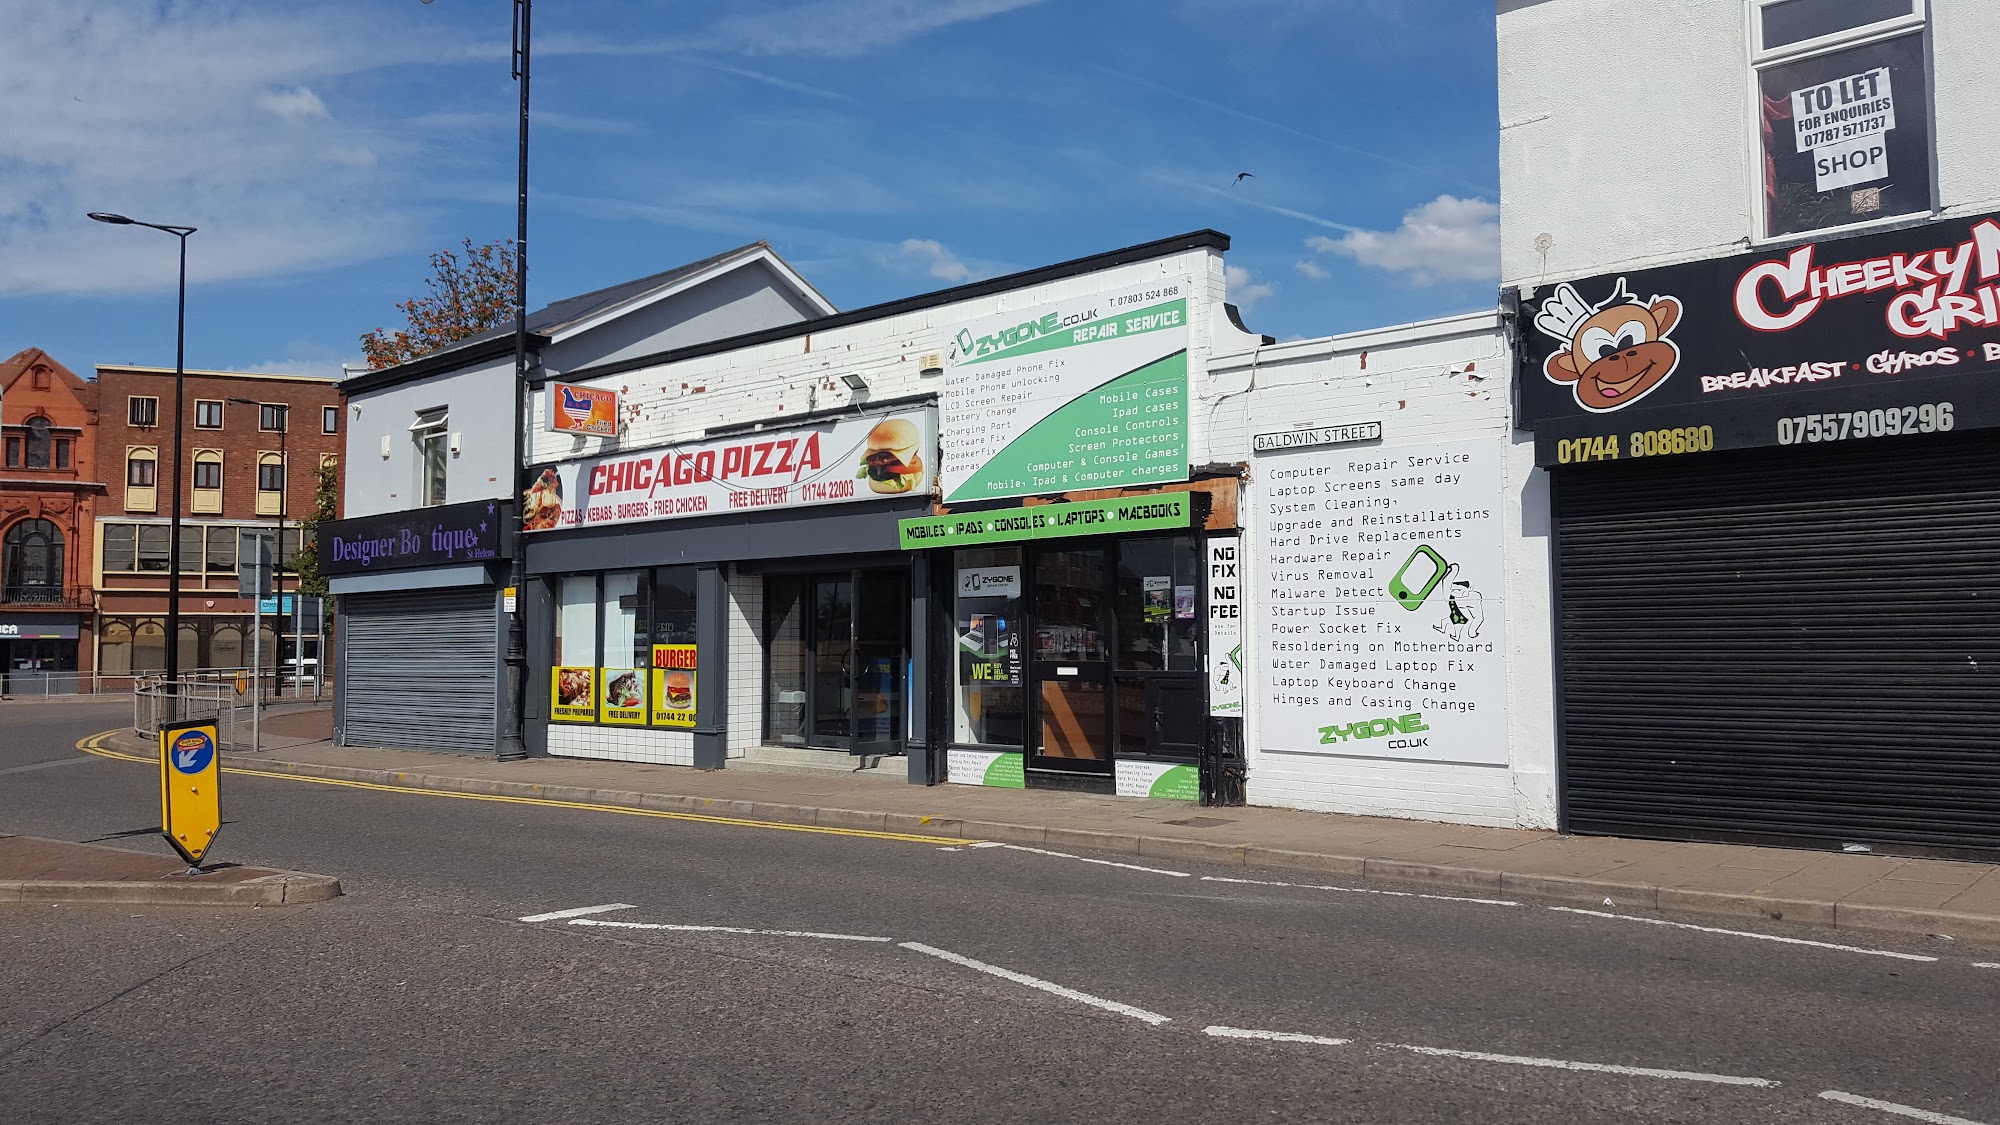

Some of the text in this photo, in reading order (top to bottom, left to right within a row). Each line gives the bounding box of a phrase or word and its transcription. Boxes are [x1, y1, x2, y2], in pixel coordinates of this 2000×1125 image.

[1800, 72, 1879, 115] TO LET
[1798, 97, 1890, 132] FOR ENQUIRIES
[1805, 115, 1886, 147] 07787 571737
[1818, 146, 1883, 176] SHOP
[1118, 293, 1142, 306] 07803
[1145, 290, 1160, 301] 524
[1162, 286, 1178, 297] 868
[1886, 283, 2000, 340] GRI
[1073, 310, 1180, 343] REPAIR SERVICE
[946, 359, 1065, 386] Water Damaged Phone Fix
[1701, 360, 1847, 394] BREAKFAST
[1866, 346, 1960, 375] GYROS
[946, 373, 1059, 398] Mobile Phone unlocking
[1100, 386, 1178, 404] Mobile Cases
[574, 391, 612, 402] CHICAGO
[946, 391, 1032, 411] LCD Screen Repair
[946, 406, 1016, 423] Battery Change
[1113, 402, 1178, 418] Ipad cases
[946, 421, 1011, 437] Charging Port
[1075, 416, 1178, 437] Console Controls
[1777, 402, 1954, 445] 07557909296
[946, 434, 1006, 448] Software Fix
[1069, 432, 1178, 453] Screen Protectors
[1258, 424, 1376, 449] BALDWIN STREET
[1557, 425, 1714, 464] 01744 808680
[588, 432, 821, 498] CHICAGO PIZZA
[946, 462, 980, 473] Cameras
[1027, 459, 1074, 472] Computer
[1081, 457, 1086, 466] &
[1094, 452, 1138, 465] Console
[1269, 453, 1470, 480] Computer Repair Service
[1033, 476, 1056, 487] Ipad
[1063, 474, 1068, 483] &
[1075, 469, 1124, 482] Computer
[1132, 463, 1178, 476] charges
[1270, 471, 1461, 498] Laptop Screens same day
[729, 479, 854, 508] FREE DELIVERY 01744 22003
[561, 496, 708, 525] PIZZAS KEBABS BURGERS FRIED CHICKEN
[1270, 502, 1315, 515] System
[907, 502, 1181, 540] MOBILES IPADS CONSOLES LAPTOPS MACBOOKS
[1270, 508, 1490, 533] Upgrade and Reinstallations
[1270, 528, 1462, 547] Hard Drive Replacements
[333, 534, 395, 566] Designer
[467, 549, 495, 559] St Helens
[1214, 547, 1234, 561] NO
[1270, 550, 1391, 564] Hardware Repair
[982, 576, 1013, 584] ZYGONE
[1212, 564, 1236, 578] FIX
[1271, 569, 1373, 582] Virus Removal
[1215, 586, 1235, 599] NO
[1272, 586, 1384, 599] Malware Detect
[1210, 605, 1238, 618] FEE
[1272, 605, 1376, 617] Startup Issue
[1272, 622, 1401, 634] Power Socket Fix
[1273, 641, 1493, 654] Resoldering on Motherboard
[972, 663, 991, 680] WE
[1272, 659, 1475, 673] Water Damaged Laptop Fix
[1273, 676, 1456, 692] Laptop Keyboard Change
[554, 707, 594, 717] FRESHLY PREPARED
[1273, 693, 1475, 713] Hinges and Casing Change
[608, 710, 640, 720] FREE DELIVERY
[656, 712, 675, 721] 01744
[677, 713, 685, 721] 22
[1388, 737, 1429, 749] CO.UK
